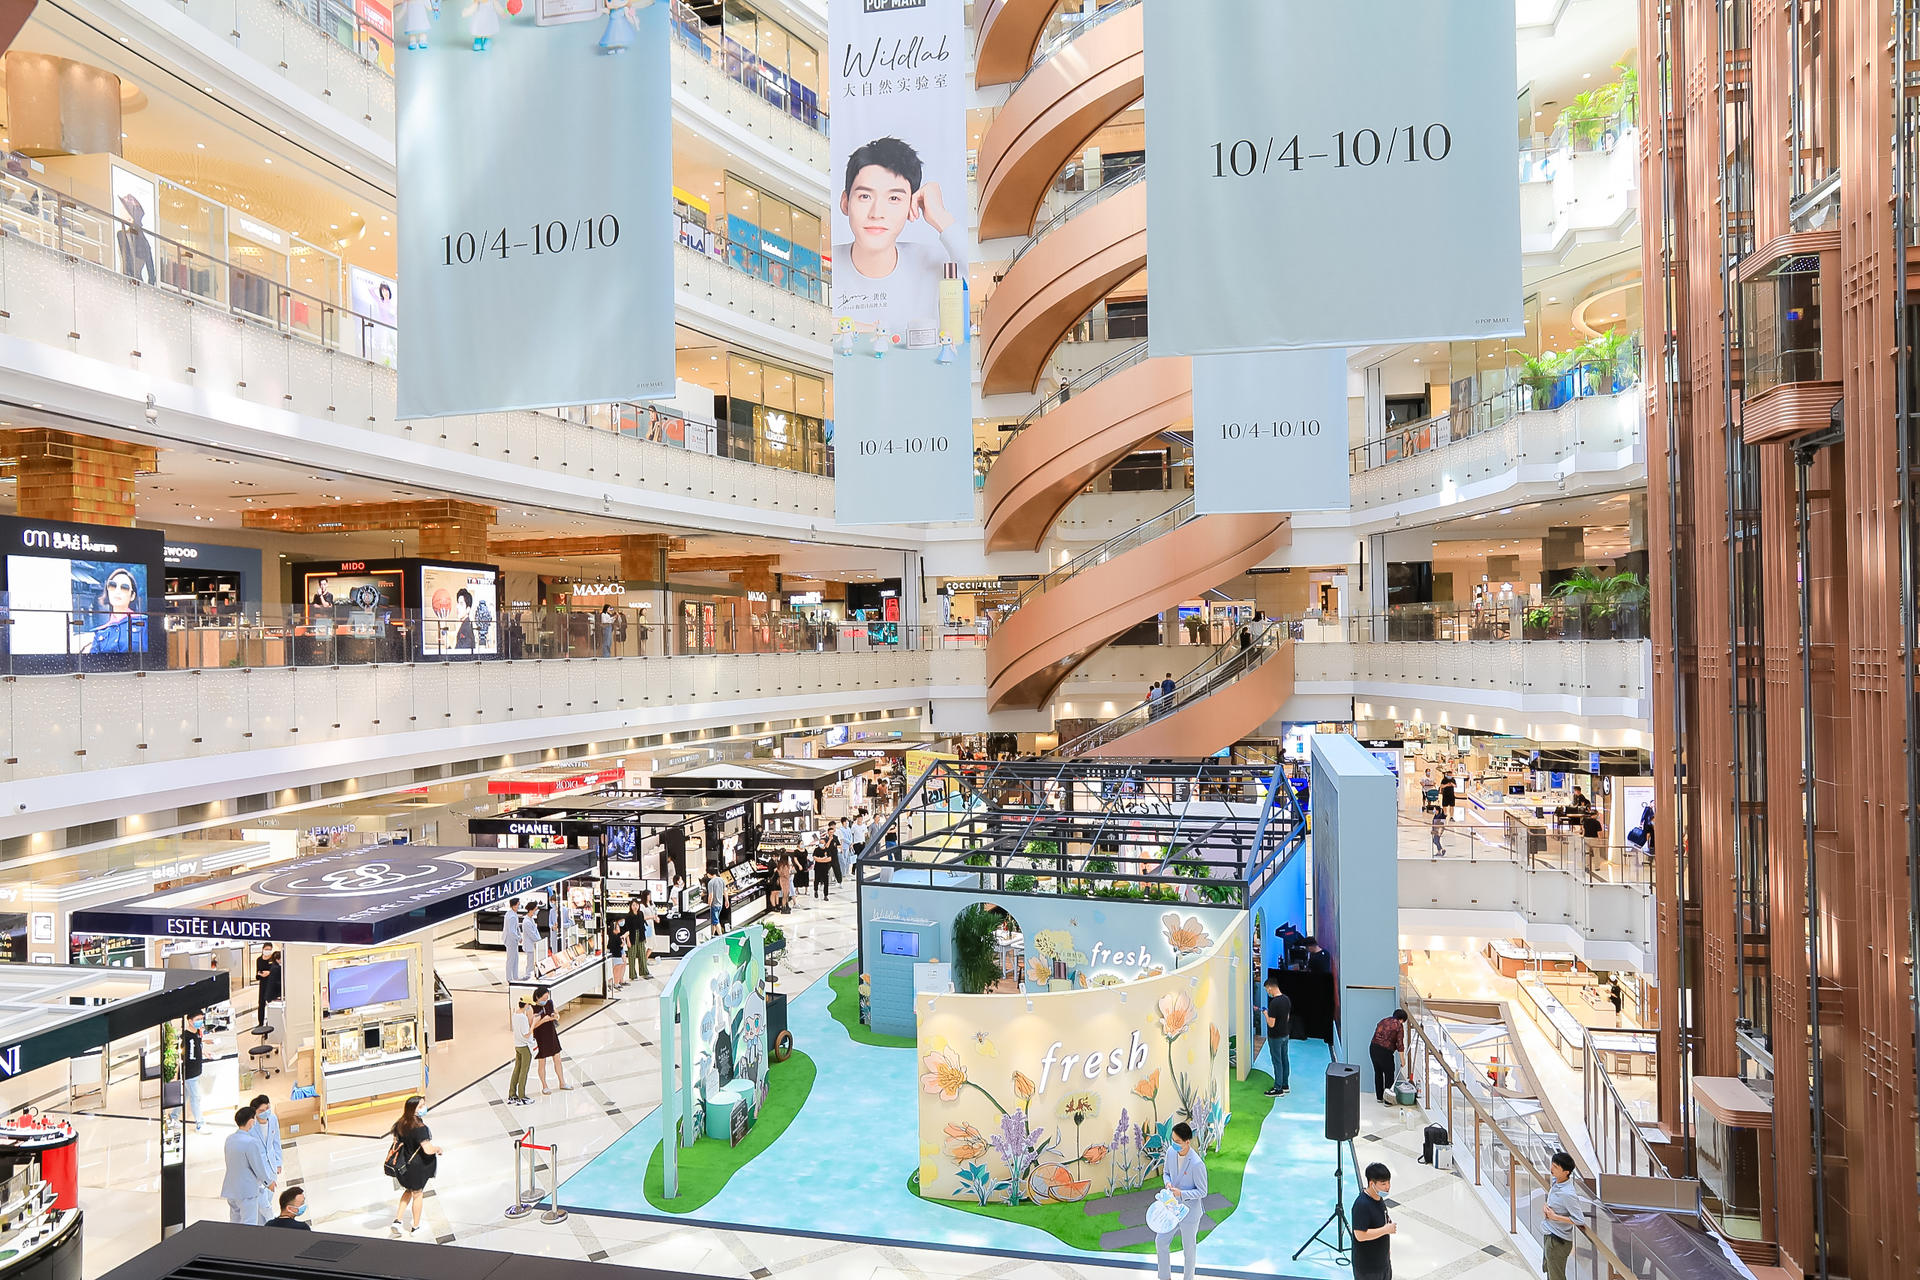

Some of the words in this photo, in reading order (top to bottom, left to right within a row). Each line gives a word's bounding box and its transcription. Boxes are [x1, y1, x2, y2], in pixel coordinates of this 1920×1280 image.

[866, 0, 889, 10] POP
[843, 35, 950, 77] Wildlab
[843, 74, 948, 97] 大自然实验室
[679, 230, 705, 254] FILA
[341, 562, 366, 570] MIDO
[716, 779, 744, 790] DIOR
[725, 804, 746, 820] CHANEL
[509, 823, 557, 835] CHANEL
[151, 861, 198, 880] sisley
[497, 875, 533, 899] LAUDER
[213, 920, 272, 938] LAUDER
[1090, 941, 1152, 968] fresh
[1038, 1029, 1149, 1094] fresh
